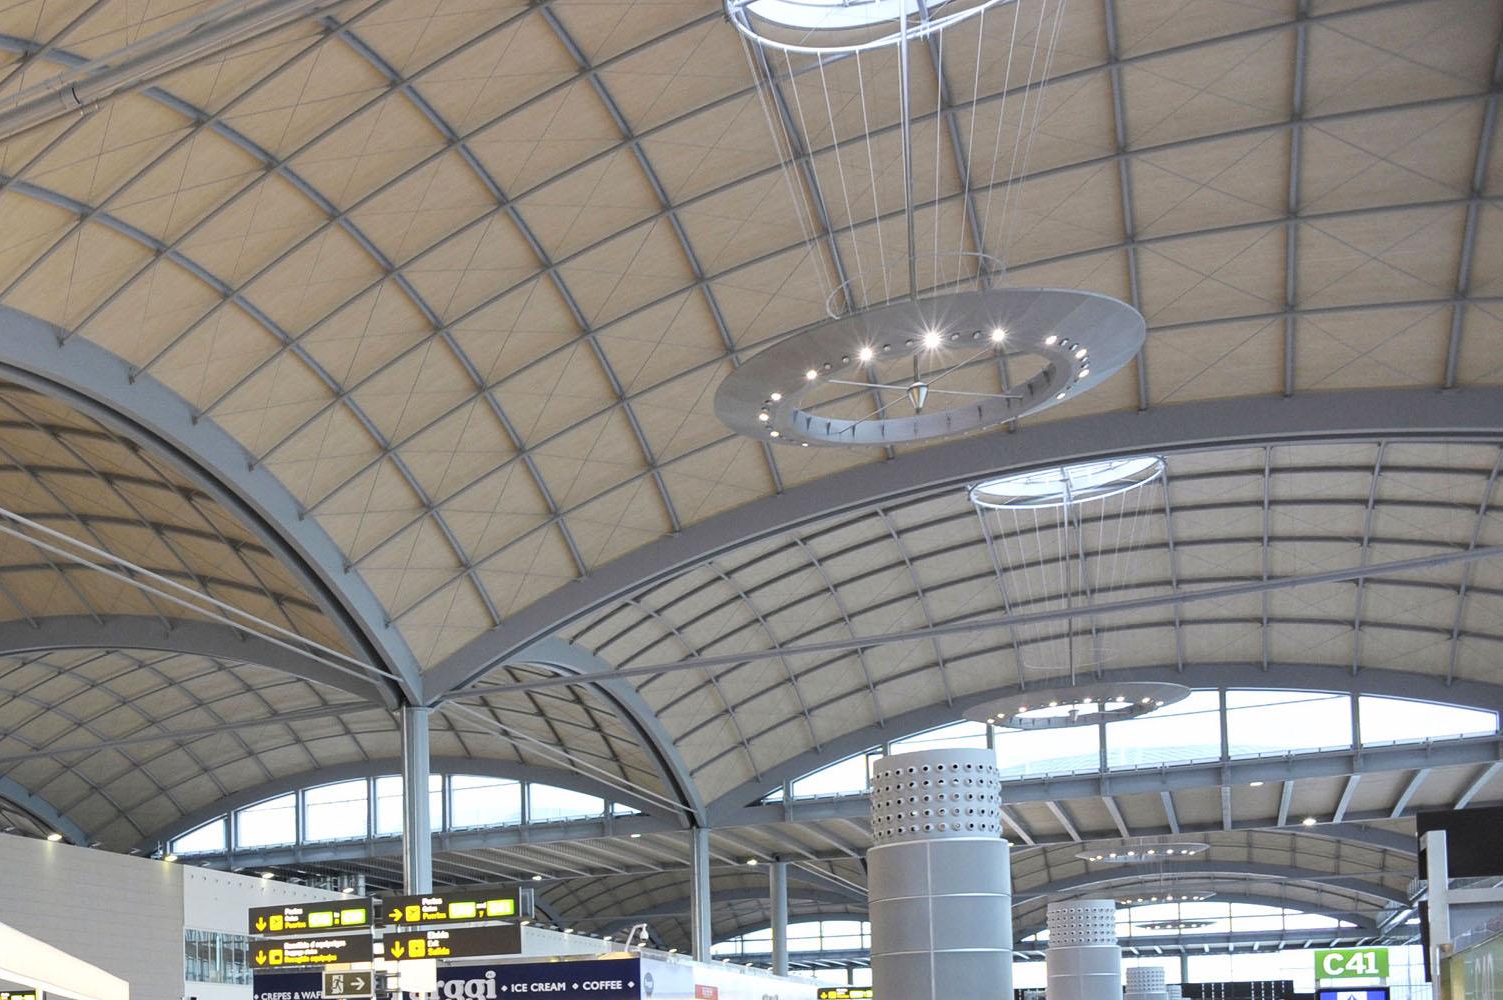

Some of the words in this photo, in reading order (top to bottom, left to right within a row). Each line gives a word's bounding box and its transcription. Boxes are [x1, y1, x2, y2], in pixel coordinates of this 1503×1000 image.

[1322, 951, 1380, 975] C41
[511, 983, 528, 993] ICE
[530, 982, 566, 992] CREAM
[582, 980, 623, 991] COFFEE
[260, 991, 292, 1000] CREPES
[293, 991, 301, 1000] &
[301, 990, 323, 1000] WAF
